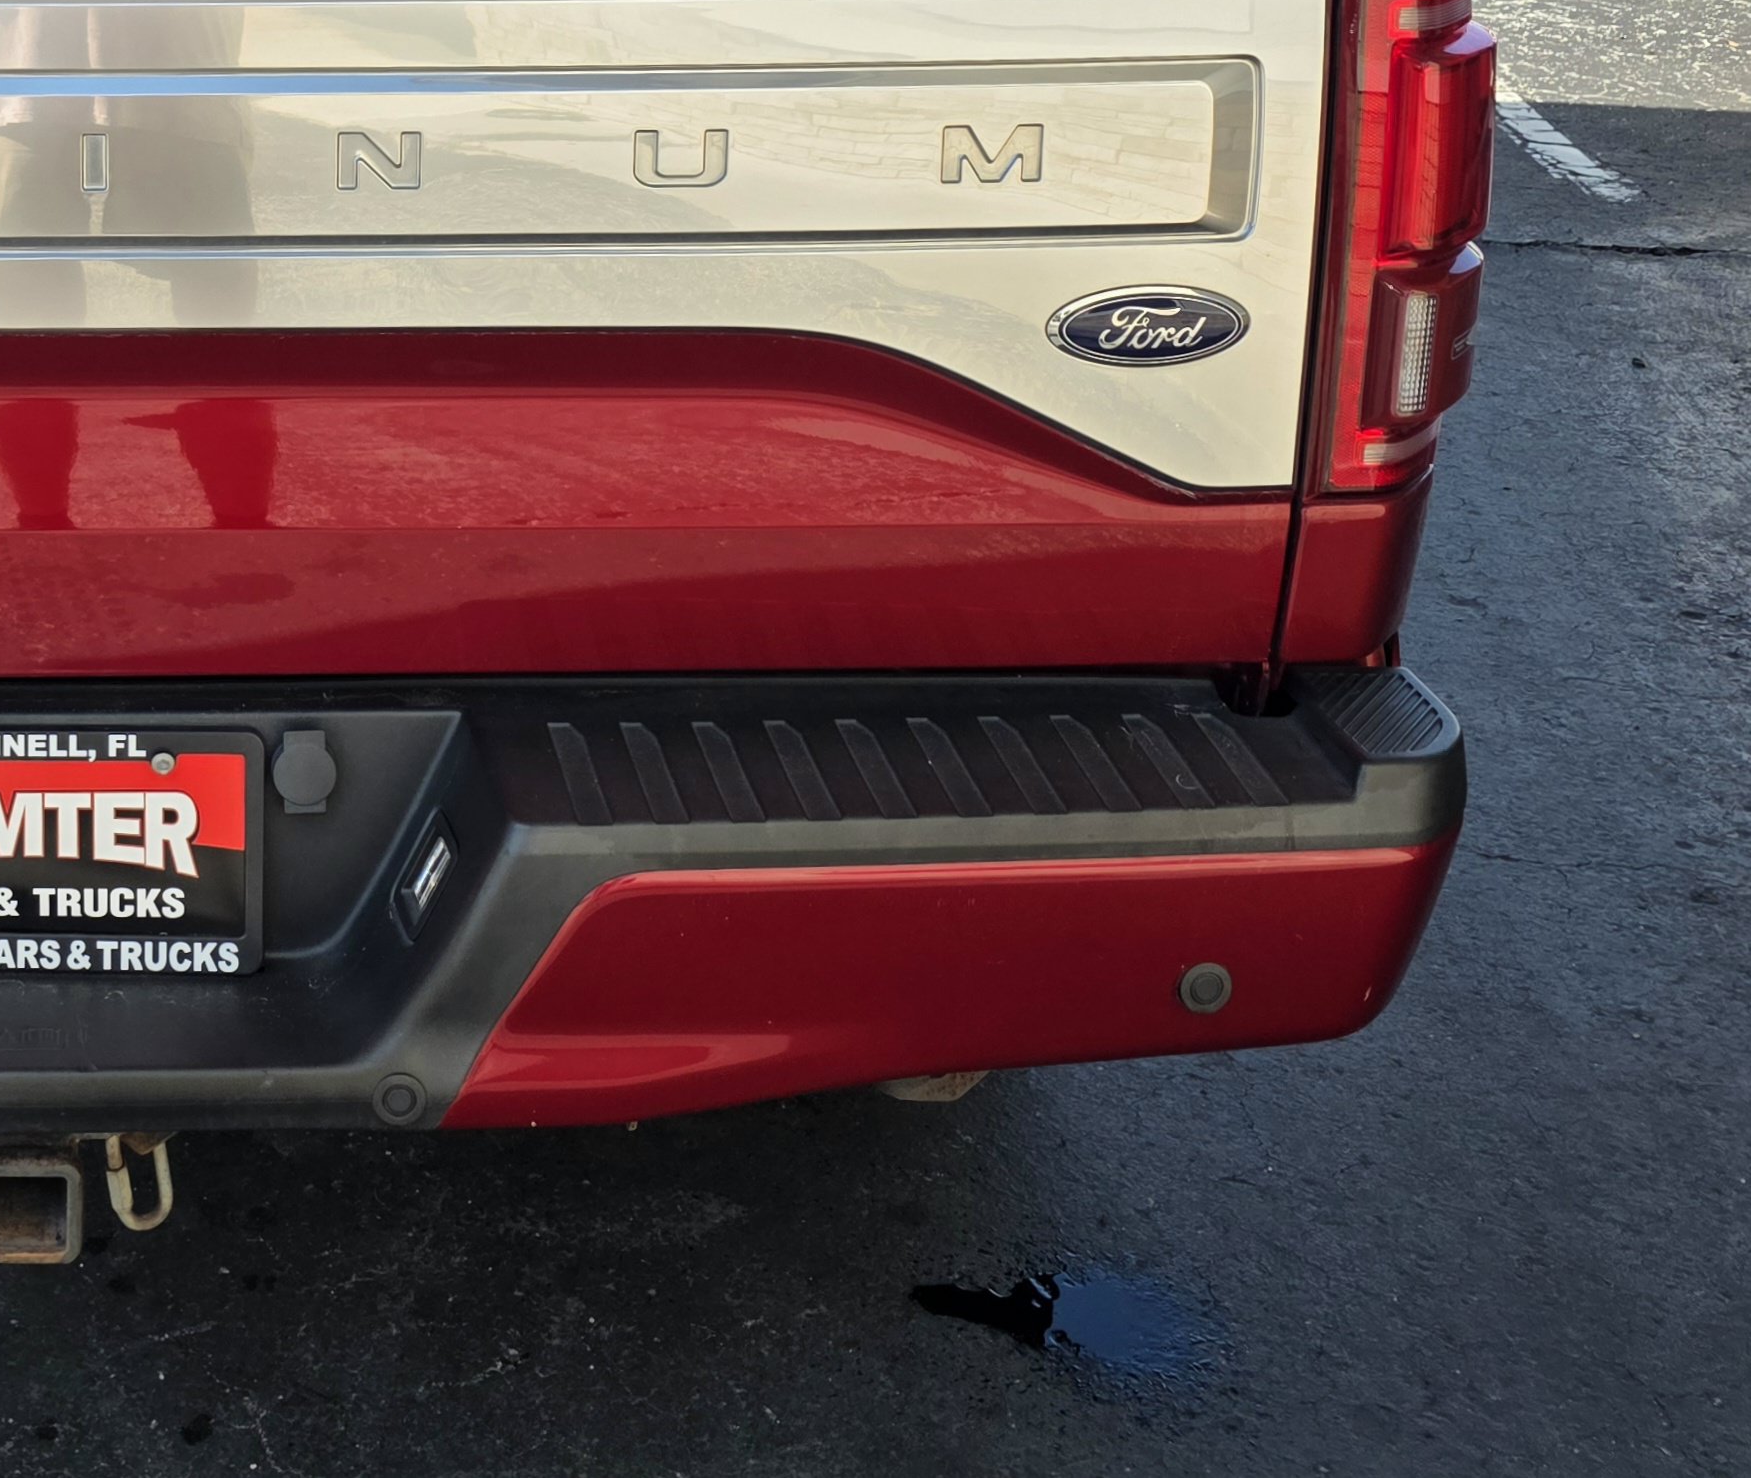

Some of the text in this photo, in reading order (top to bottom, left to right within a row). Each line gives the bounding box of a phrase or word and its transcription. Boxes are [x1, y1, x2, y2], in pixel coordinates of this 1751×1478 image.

[1098, 306, 1207, 350] Ford
[107, 735, 147, 758] FL
[32, 887, 186, 919] TRUCKS
[66, 941, 92, 971] &
[95, 940, 240, 973] TRUCKS
